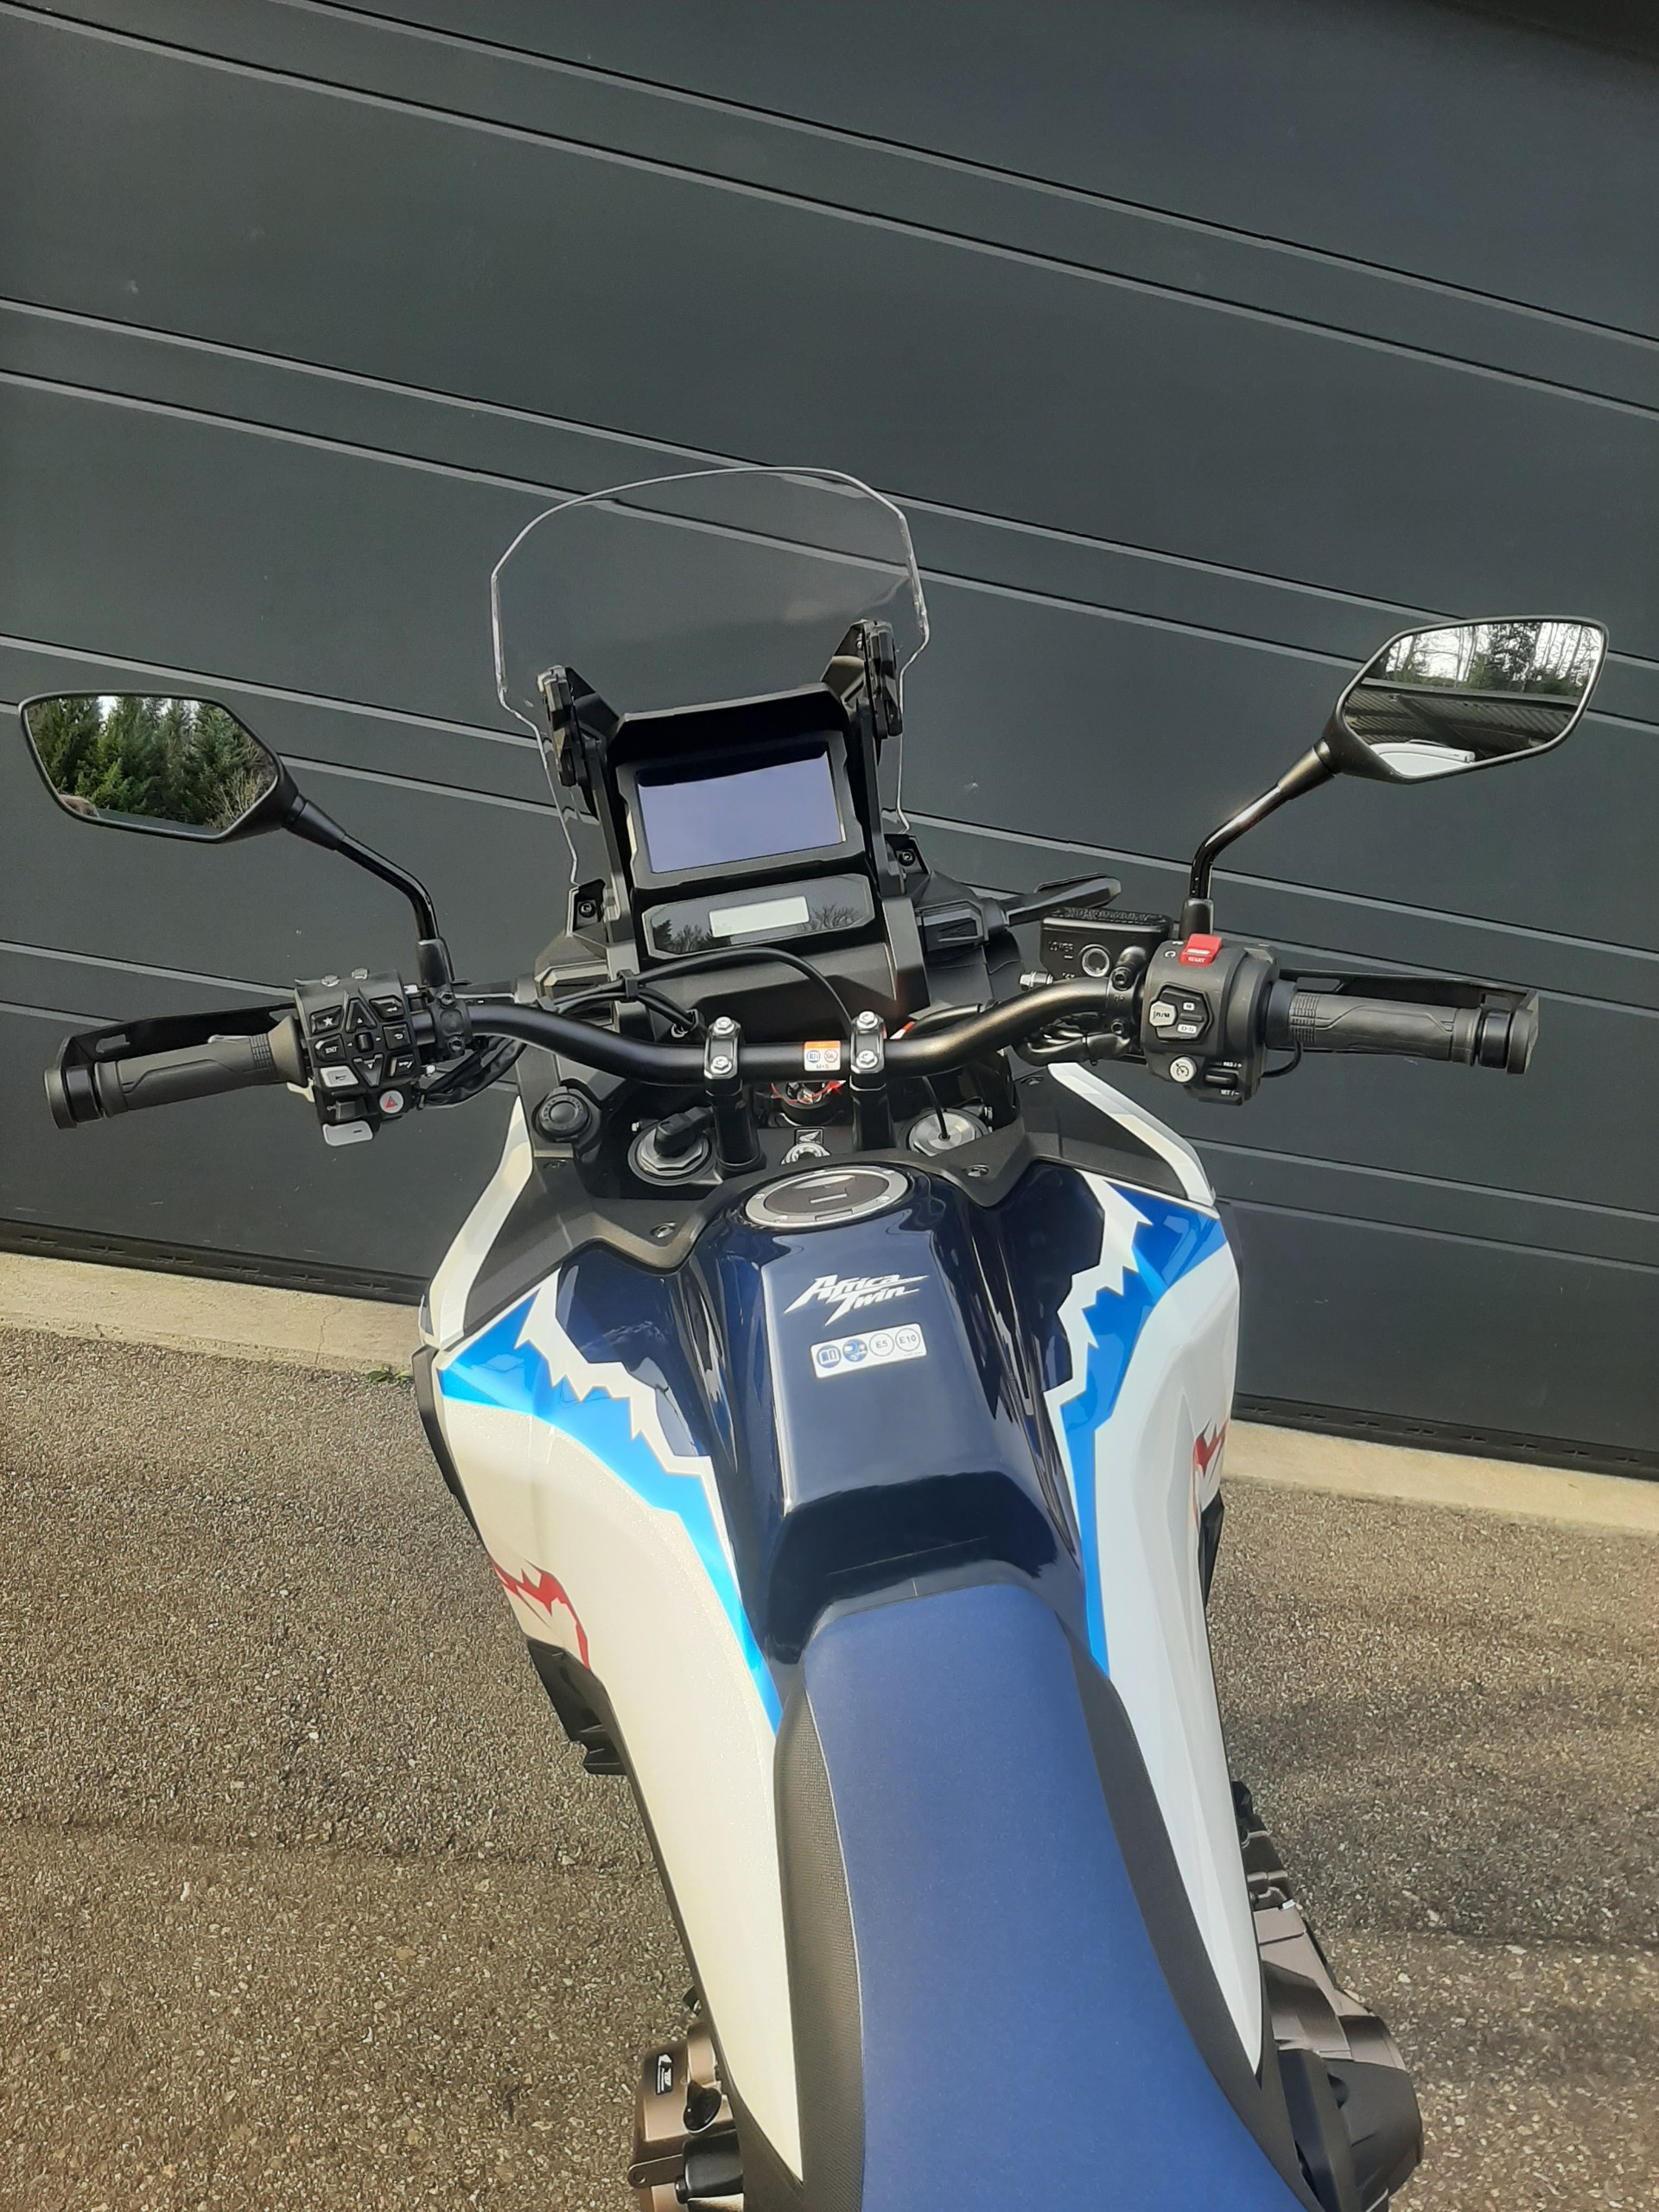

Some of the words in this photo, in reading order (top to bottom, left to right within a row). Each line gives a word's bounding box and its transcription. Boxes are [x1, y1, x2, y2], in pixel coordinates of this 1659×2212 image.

[783, 1274, 930, 1314] Africa
[823, 1287, 921, 1327] Twin
[875, 1339, 888, 1349] E5
[899, 1334, 917, 1344] E10
